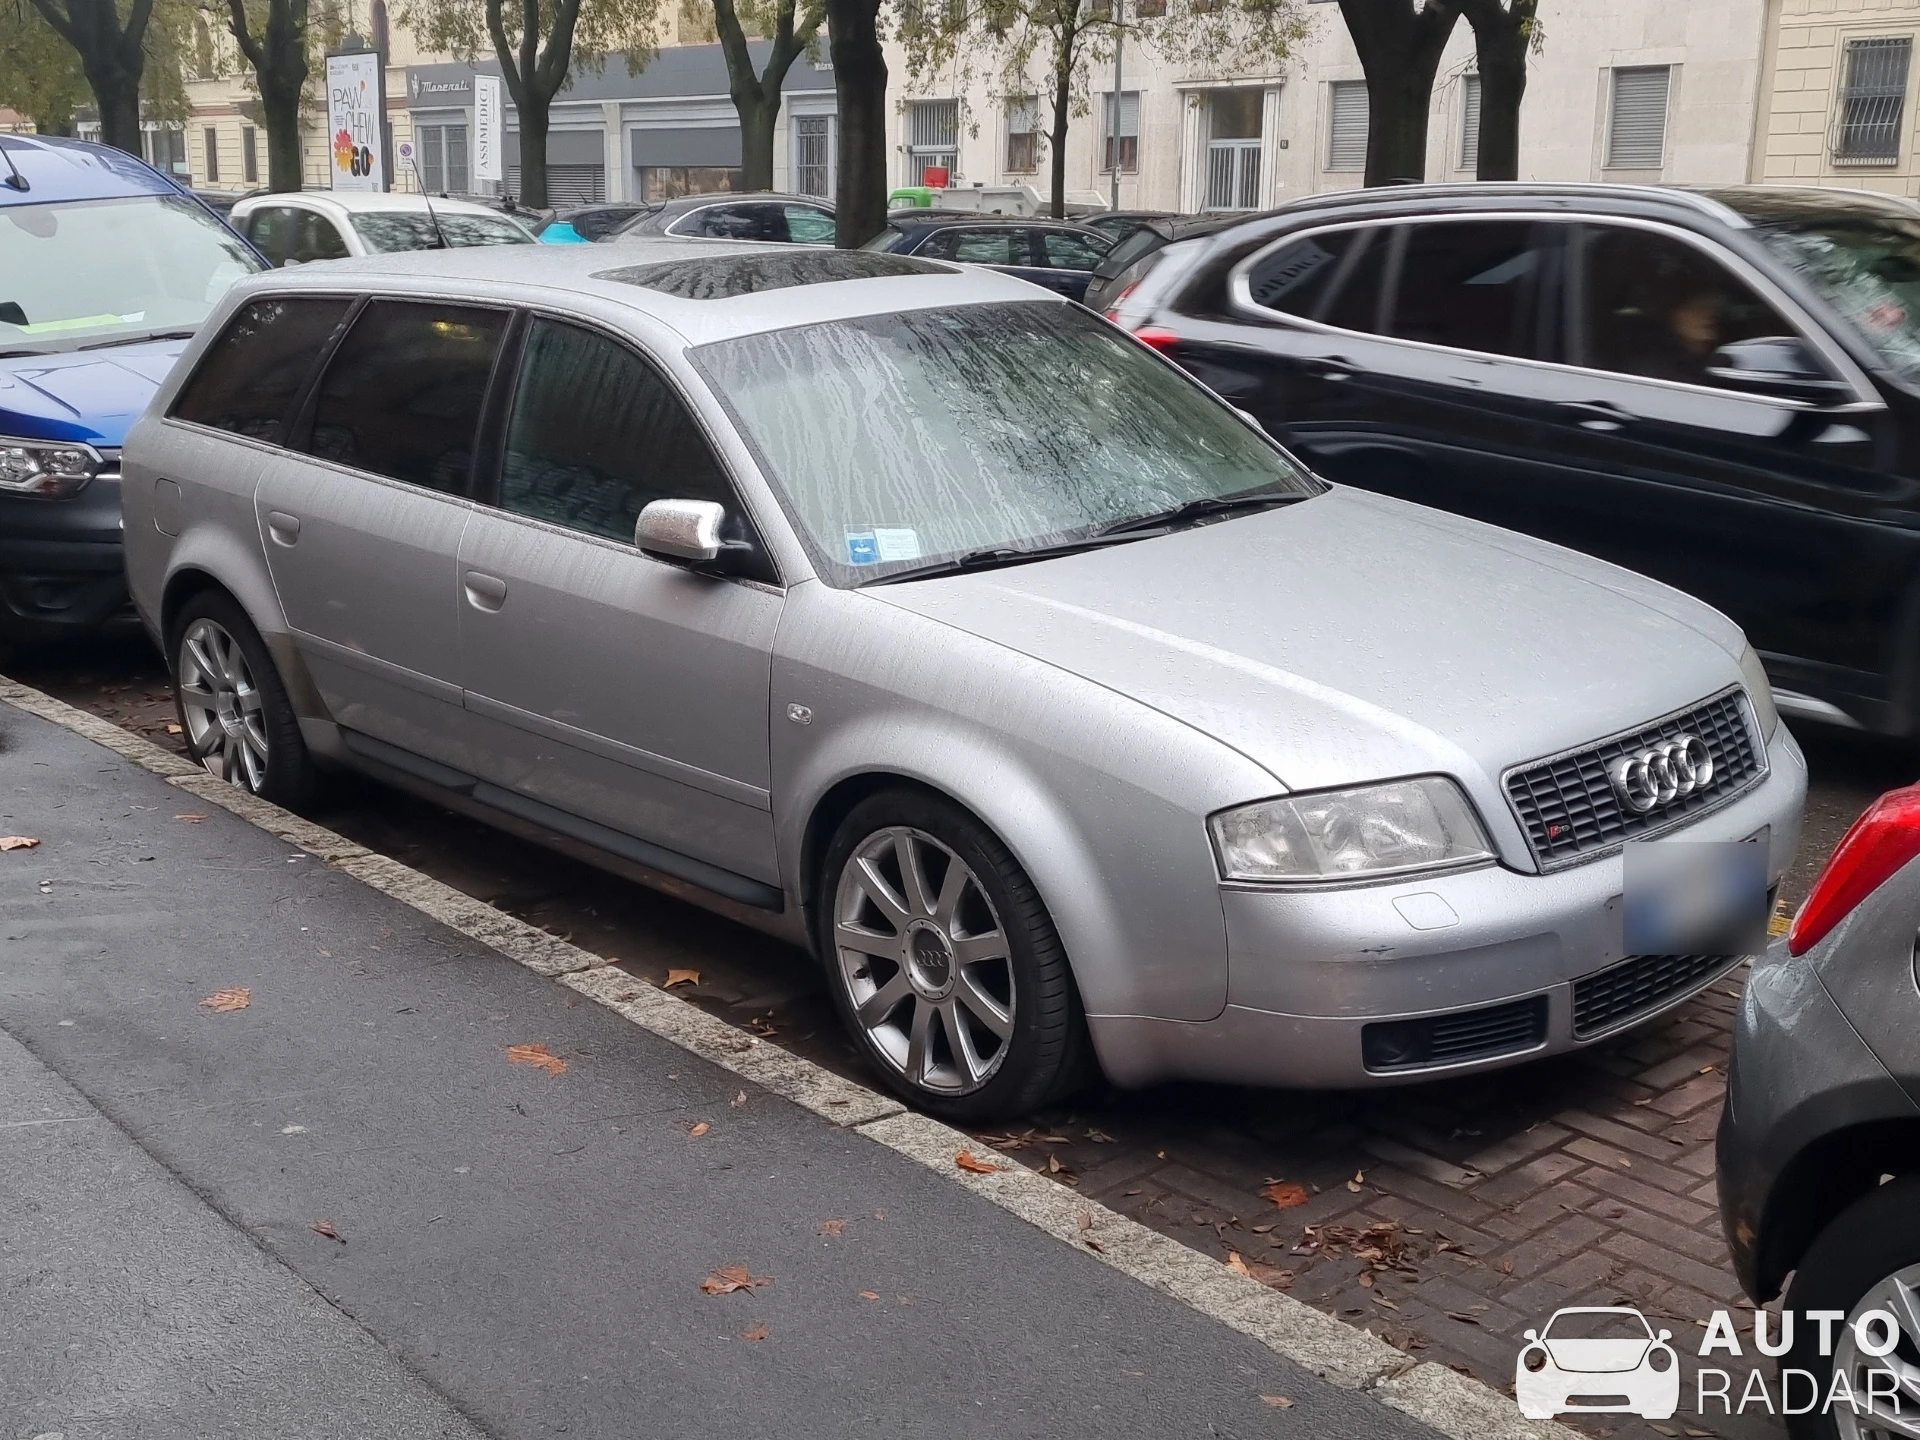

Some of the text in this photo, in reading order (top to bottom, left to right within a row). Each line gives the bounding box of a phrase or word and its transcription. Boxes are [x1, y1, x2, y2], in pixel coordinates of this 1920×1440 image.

[332, 86, 362, 112] PAW
[421, 80, 470, 92] Maserati
[345, 110, 375, 145] CHEW
[350, 146, 371, 177] GO
